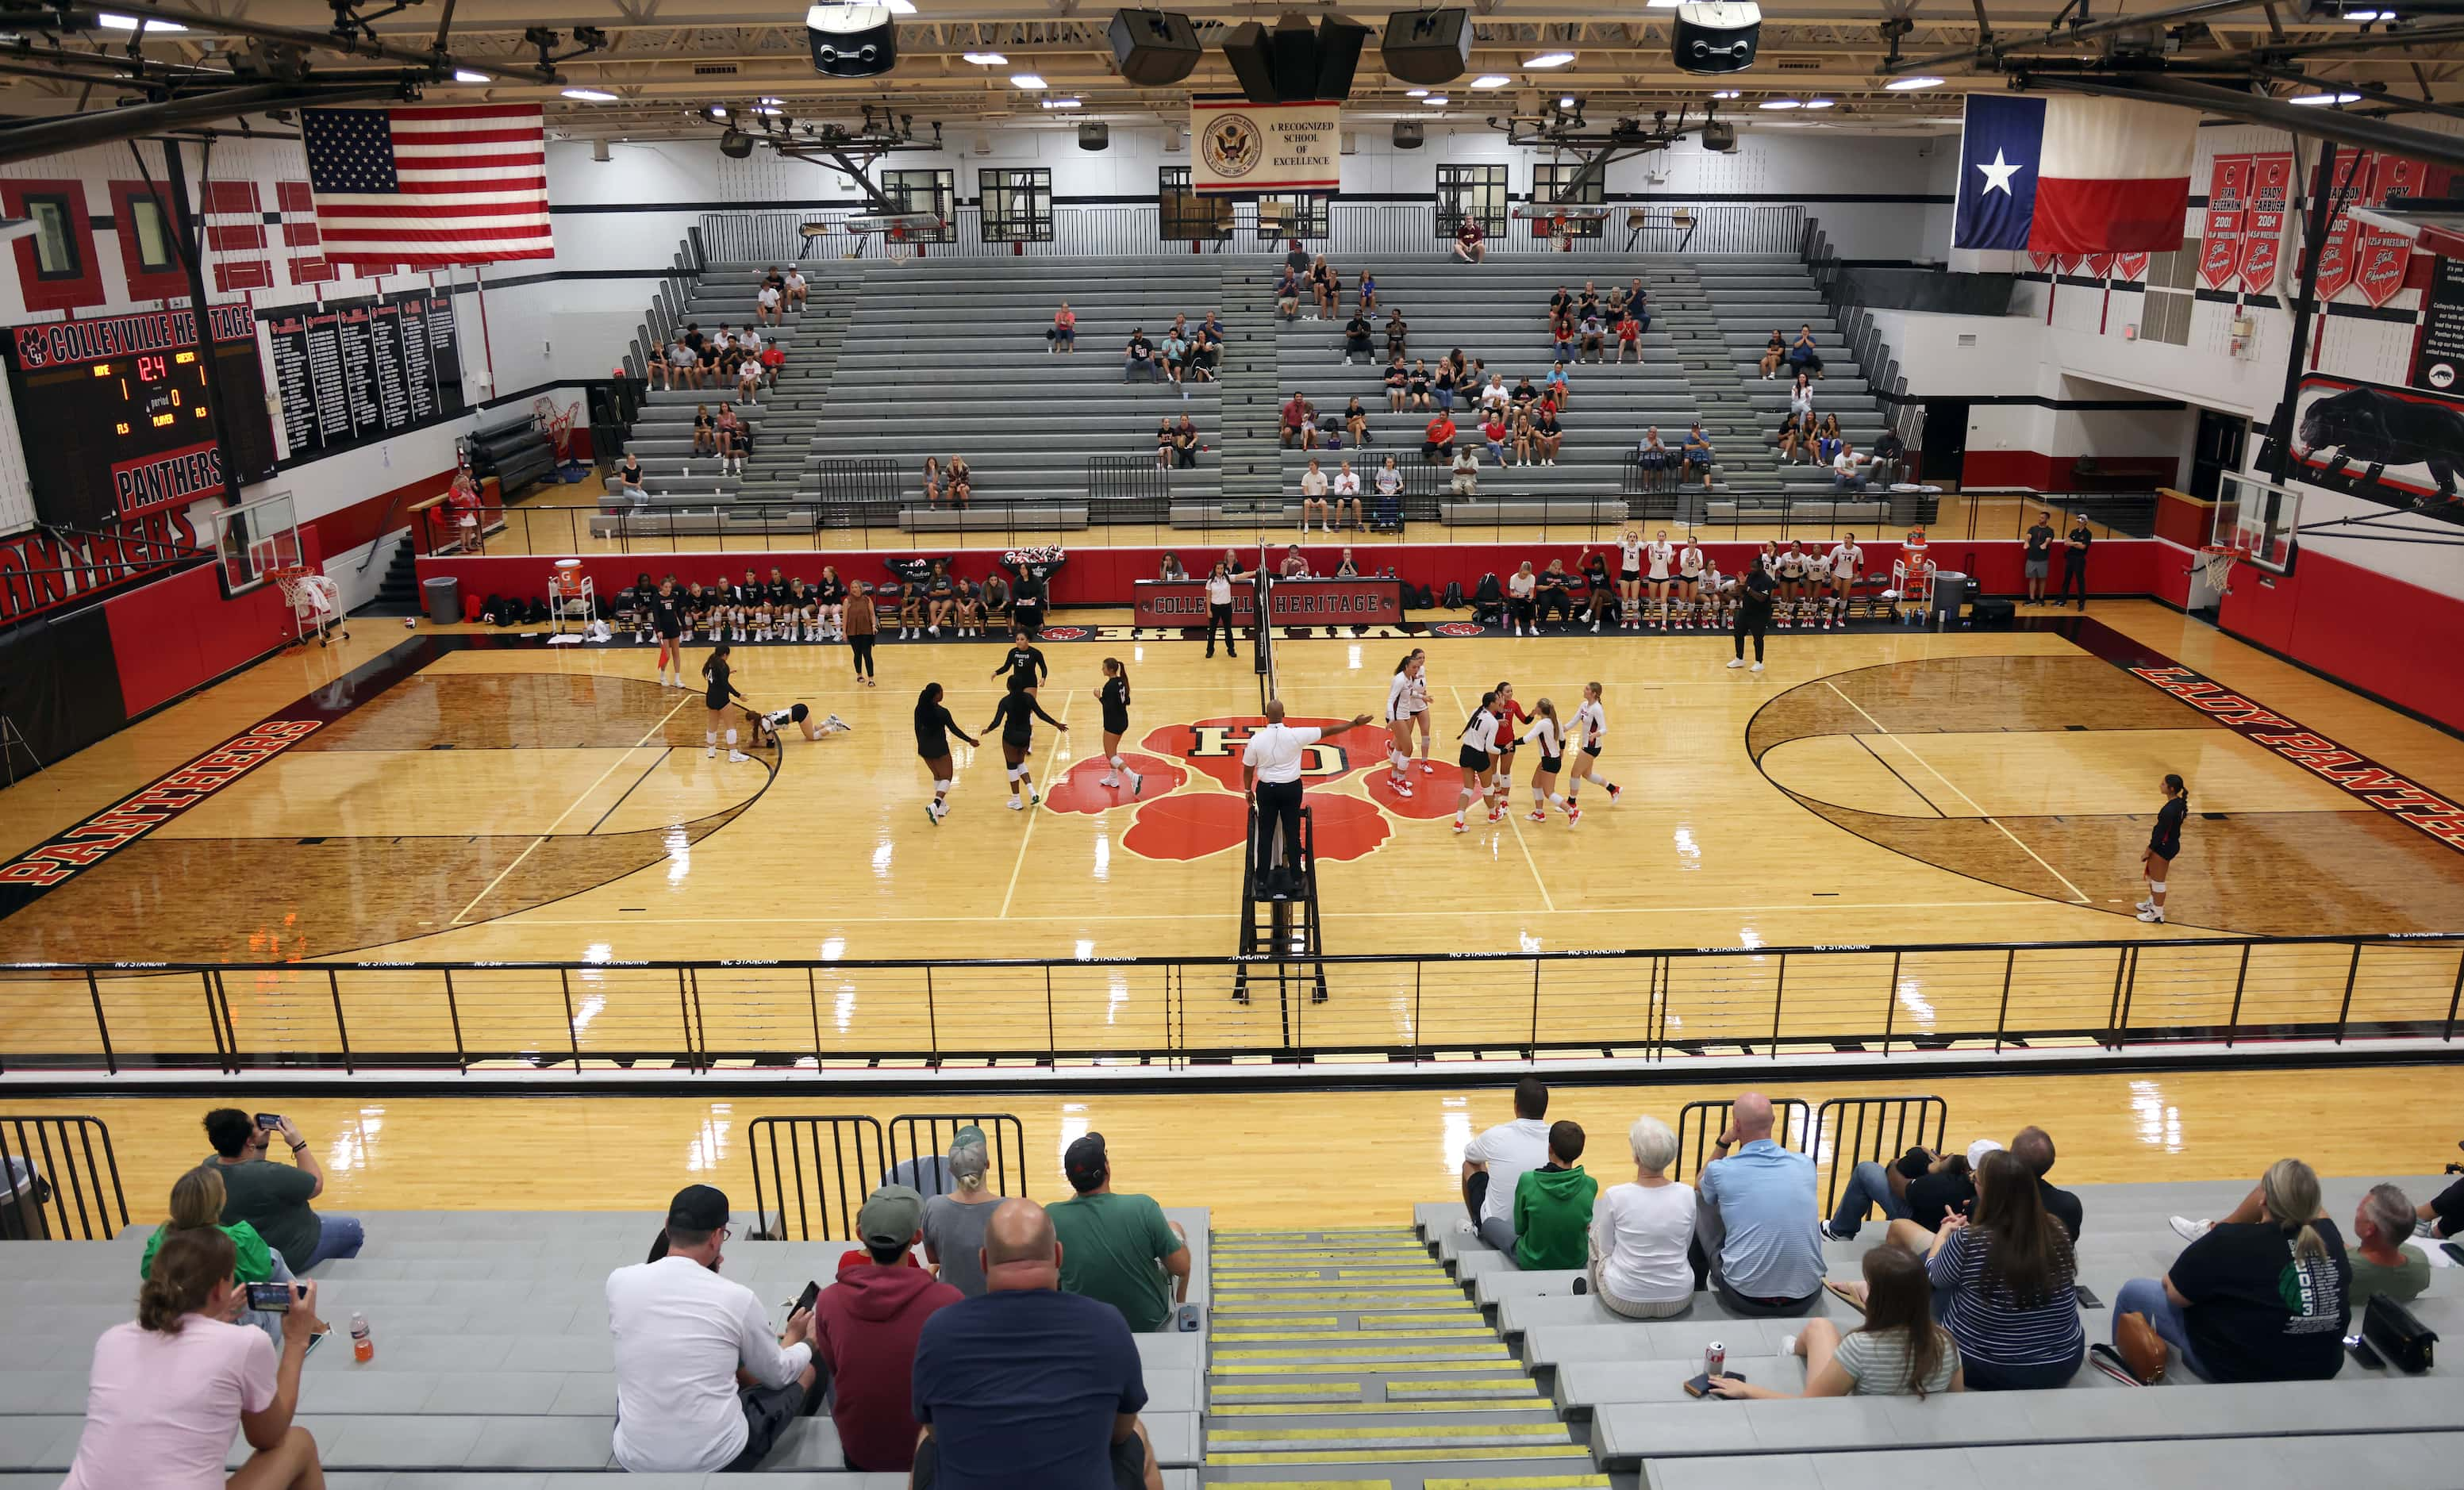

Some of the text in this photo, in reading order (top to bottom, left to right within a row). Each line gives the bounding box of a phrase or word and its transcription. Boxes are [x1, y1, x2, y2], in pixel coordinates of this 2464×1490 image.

[1278, 121, 1334, 132] RECOGNIZED
[1284, 133, 1319, 143] SCHOOL
[1296, 145, 1308, 154] OF
[1274, 156, 1330, 166] EXCELLENCE
[2260, 186, 2283, 198] BRADY
[2215, 217, 2232, 228] 2001
[2258, 216, 2276, 226] 2004
[2330, 220, 2349, 232] 005
[48, 305, 253, 363] COLLEYVILLE HETAGE
[175, 351, 194, 364] GUESTS
[93, 364, 111, 377] HOME
[137, 355, 167, 382] 12.4
[151, 396, 169, 409] period
[171, 389, 181, 407] 0
[195, 407, 206, 417] FLS
[152, 413, 174, 427] PLAYER
[117, 424, 129, 435] FLS
[116, 447, 223, 512] PANTHERS
[1912, 554, 1922, 563] G
[560, 570, 571, 582] G
[1274, 595, 1378, 613] HERITAGE
[1018, 659, 1024, 667] 5
[2128, 666, 2297, 725] LADY
[0, 720, 323, 886] PANTHERS
